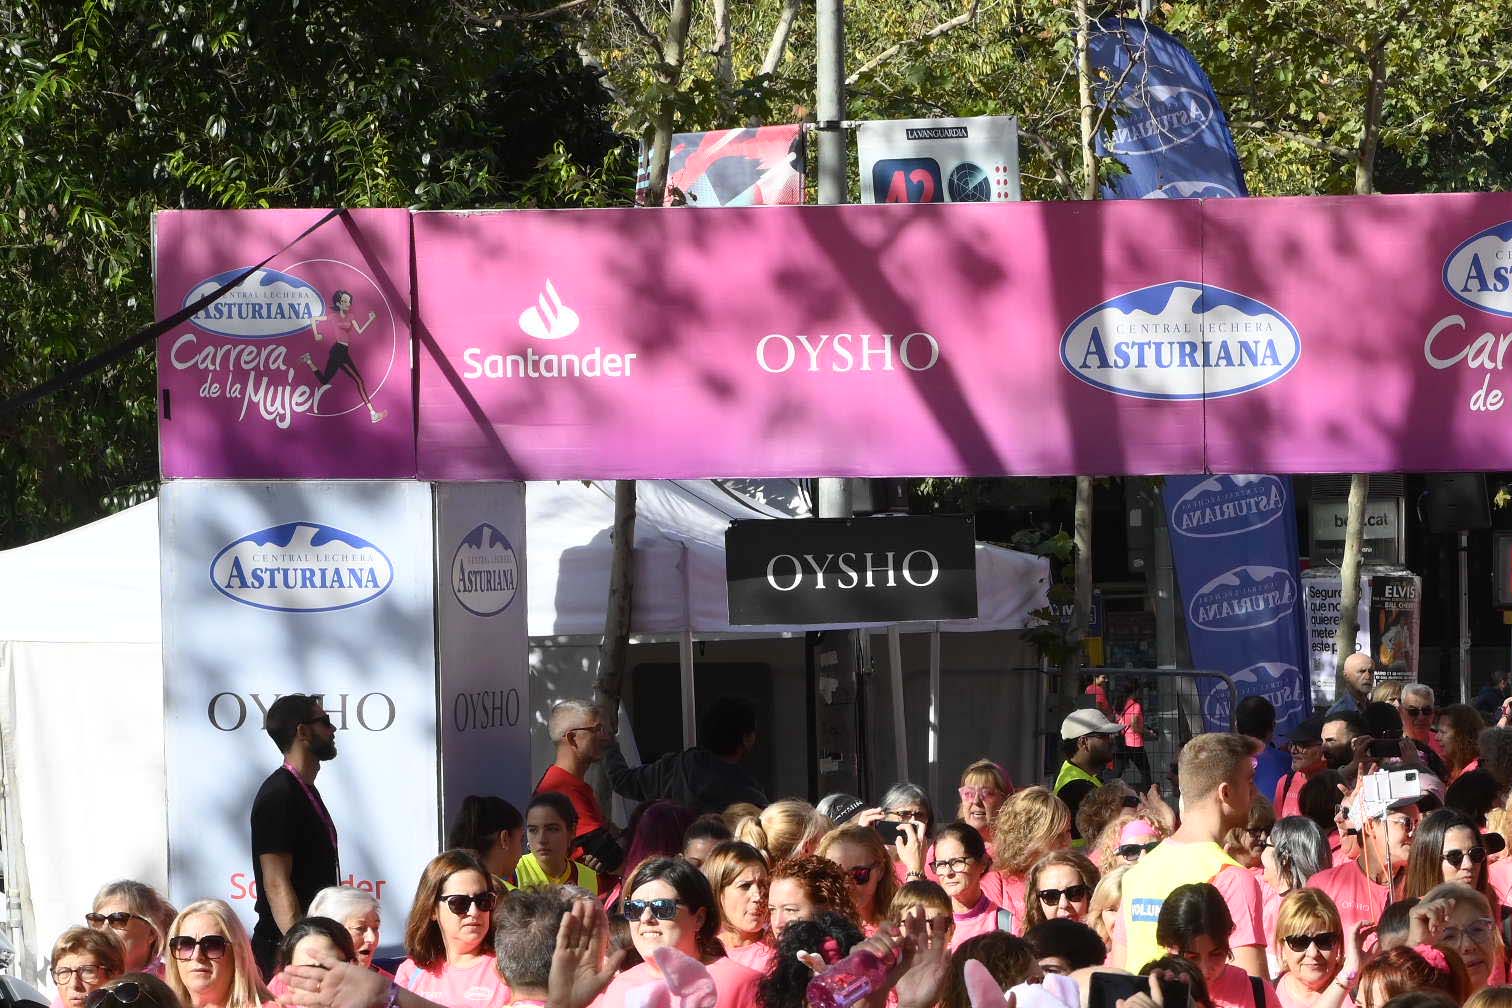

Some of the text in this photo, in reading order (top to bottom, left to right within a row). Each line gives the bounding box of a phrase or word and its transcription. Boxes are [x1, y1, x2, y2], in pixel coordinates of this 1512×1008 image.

[194, 293, 313, 321] ASTURIANA
[216, 290, 259, 300] ENTRAL
[1116, 321, 1273, 334] CENTRAL LECHERA
[170, 334, 288, 371] Carrera
[463, 346, 637, 379] Santander
[755, 331, 940, 374] OYSHO
[1078, 326, 1282, 369] ASTURIANA
[199, 367, 332, 429] de la Mujer
[1469, 374, 1503, 412] de
[224, 556, 381, 591] ASTURIANA
[253, 552, 375, 563] CENTRAL LECHERA
[766, 549, 940, 591] OYSHO
[456, 558, 515, 594] ASTURIANA
[1385, 585, 1415, 598] ELVIS
[1311, 640, 1331, 652] este
[207, 692, 397, 733] OYHO
[454, 688, 520, 732] OYSHO
